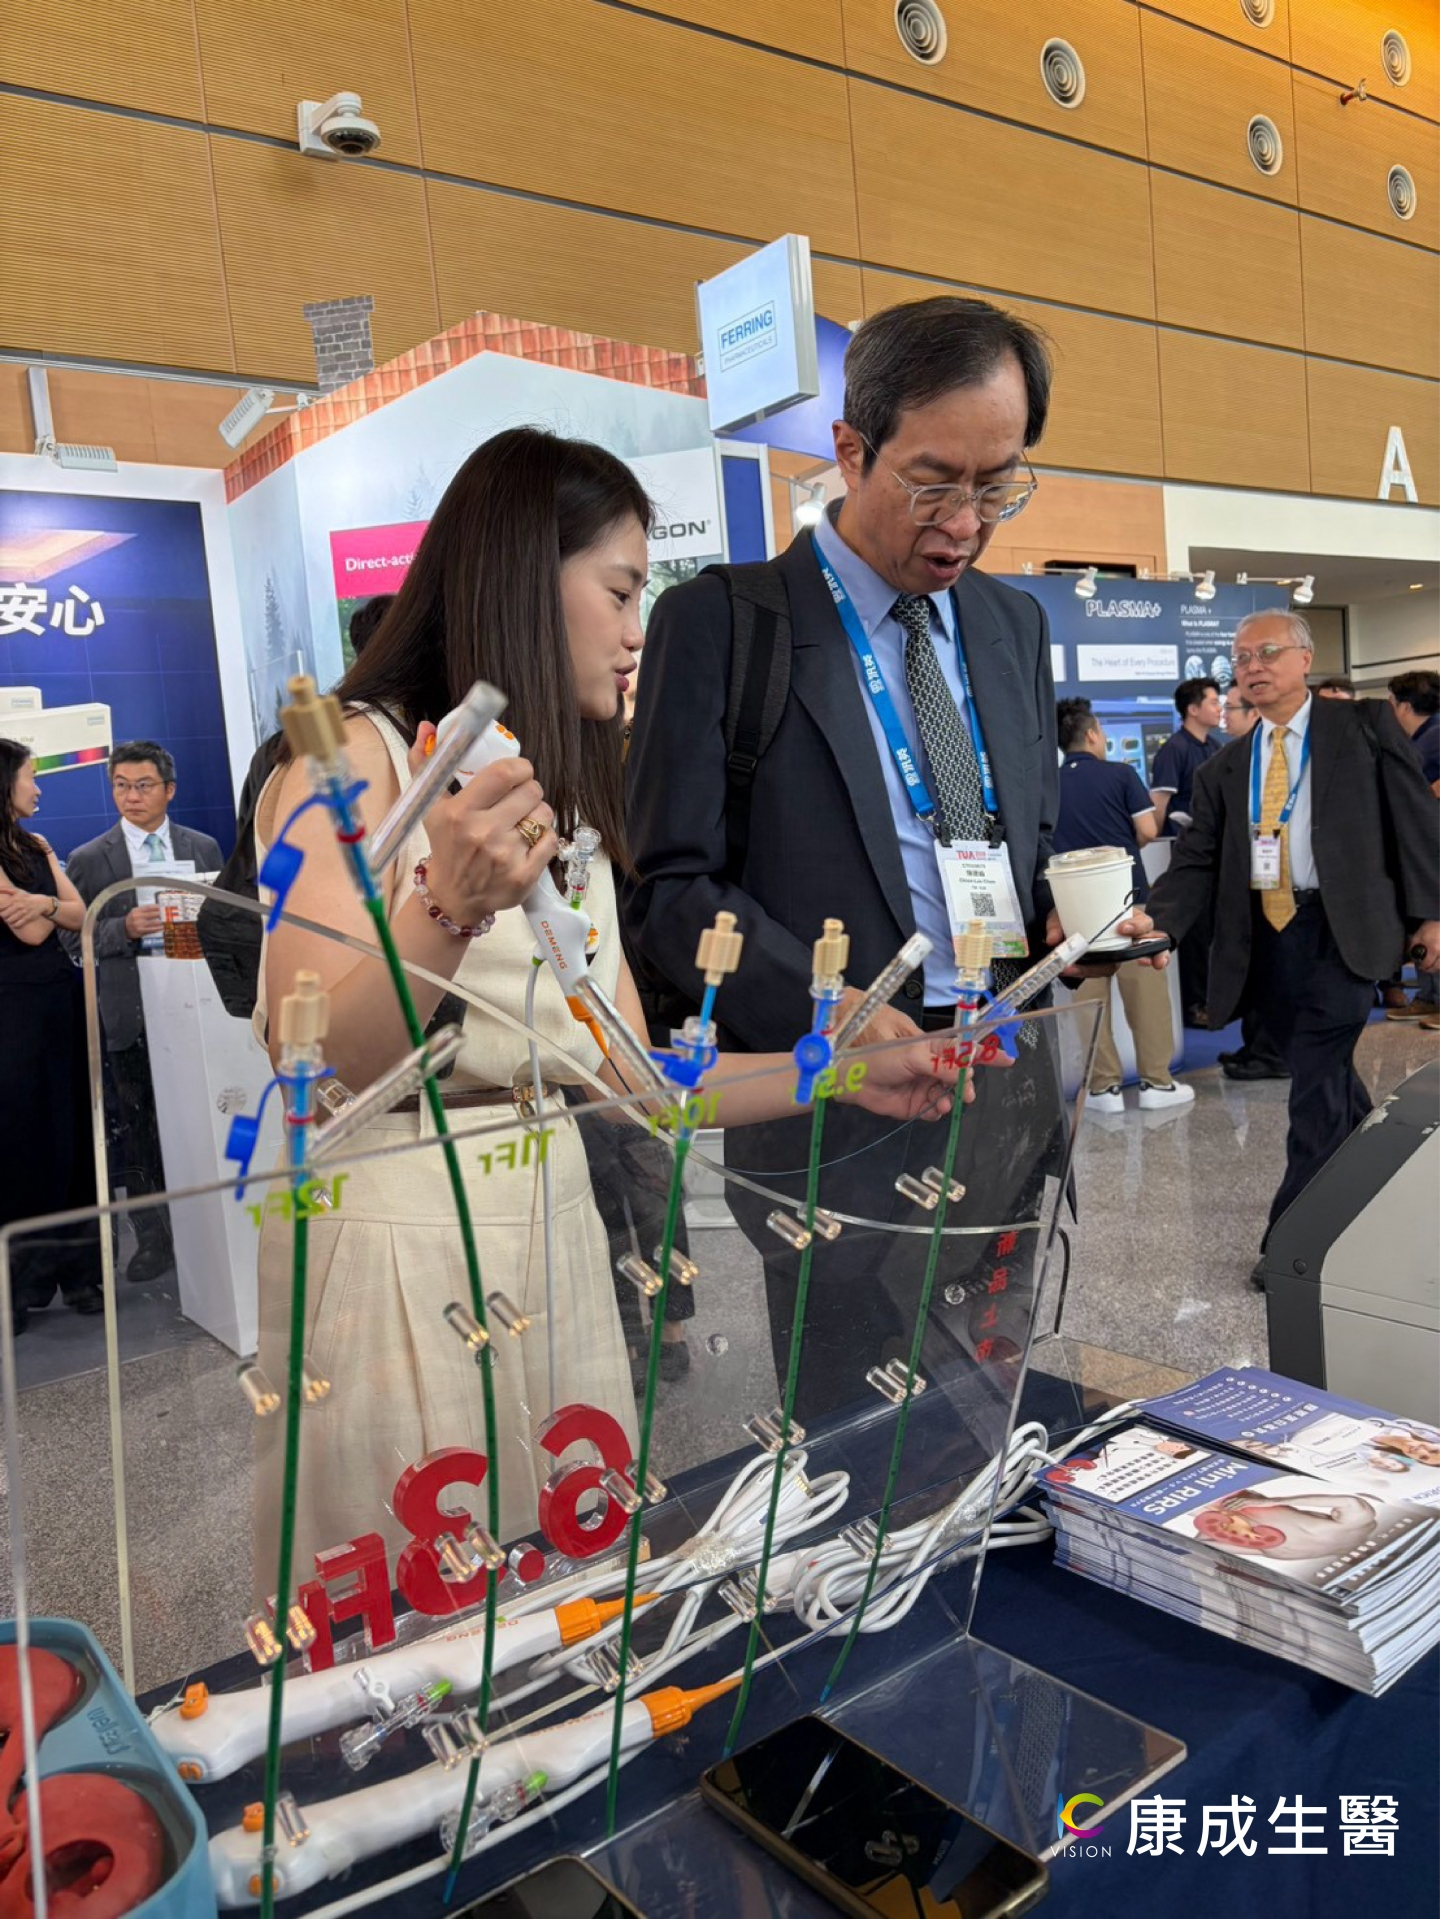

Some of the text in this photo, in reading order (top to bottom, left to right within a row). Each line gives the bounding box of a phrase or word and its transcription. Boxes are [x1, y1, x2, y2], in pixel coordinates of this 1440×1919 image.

[721, 309, 773, 349] FERRING
[1377, 425, 1418, 503] A
[651, 520, 706, 540] GON
[0, 582, 105, 636] 安心
[1194, 1461, 1249, 1489] Mini
[1143, 1485, 1202, 1516] RIRS
[445, 1618, 519, 1642] DEENG
